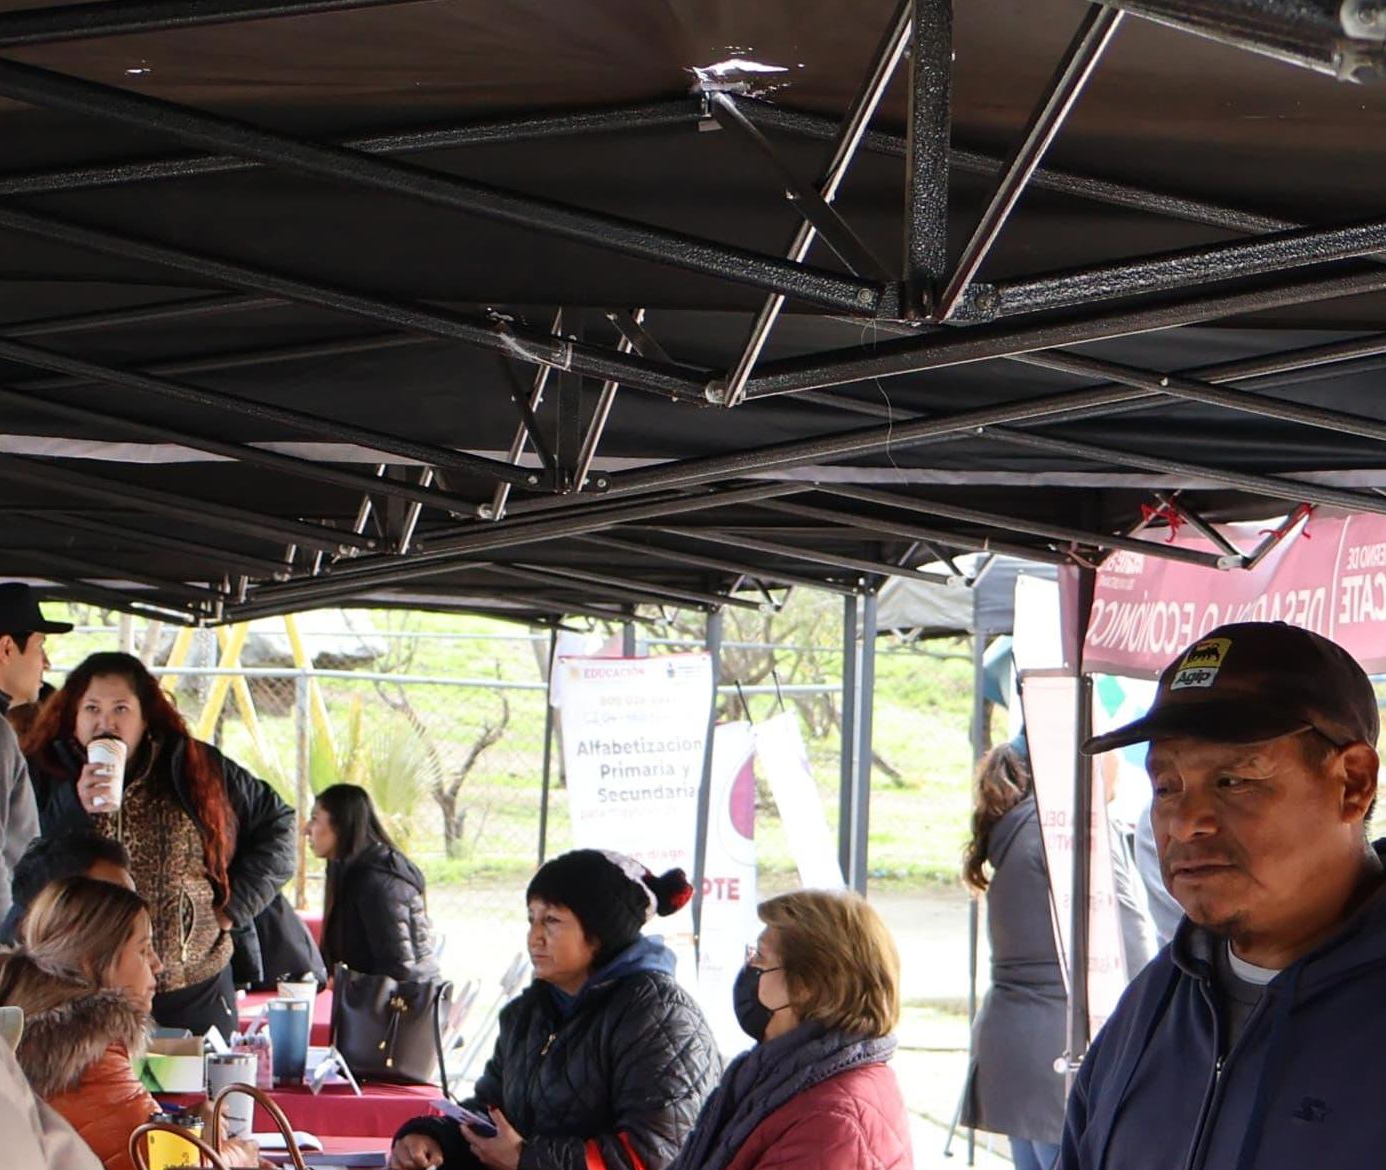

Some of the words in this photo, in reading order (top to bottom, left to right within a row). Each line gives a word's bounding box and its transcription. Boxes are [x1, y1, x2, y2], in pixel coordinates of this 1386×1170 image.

[1175, 669, 1213, 686] Agip
[600, 762, 675, 779] Primaria
[597, 785, 696, 803] Secundaria
